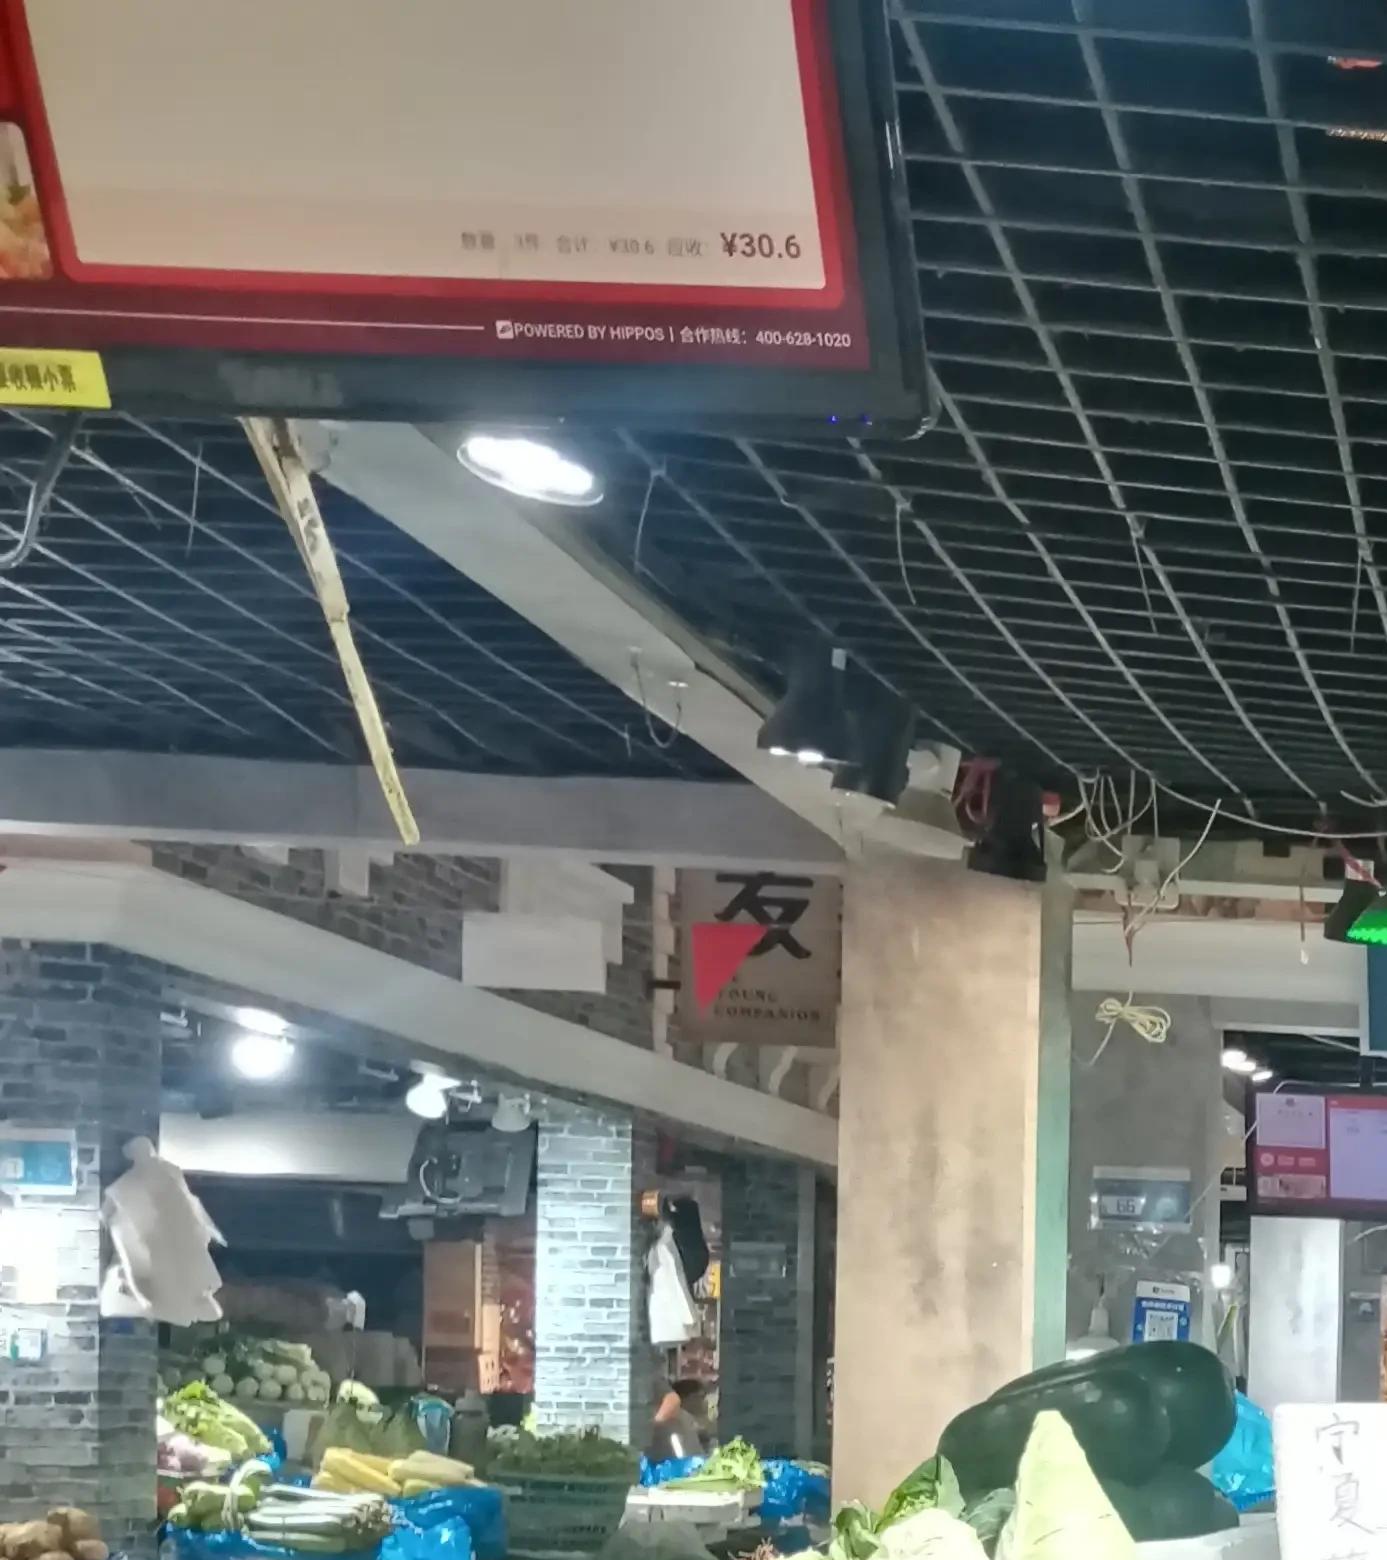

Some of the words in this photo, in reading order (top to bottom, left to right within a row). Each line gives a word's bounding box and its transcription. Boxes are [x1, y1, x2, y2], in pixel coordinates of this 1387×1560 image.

[720, 231, 802, 259] ¥30.6
[513, 322, 585, 340] POWERED
[587, 325, 607, 341] BY
[609, 325, 666, 343] HIPPOS
[754, 330, 852, 349] 400-628-1020
[713, 872, 815, 960] 友
